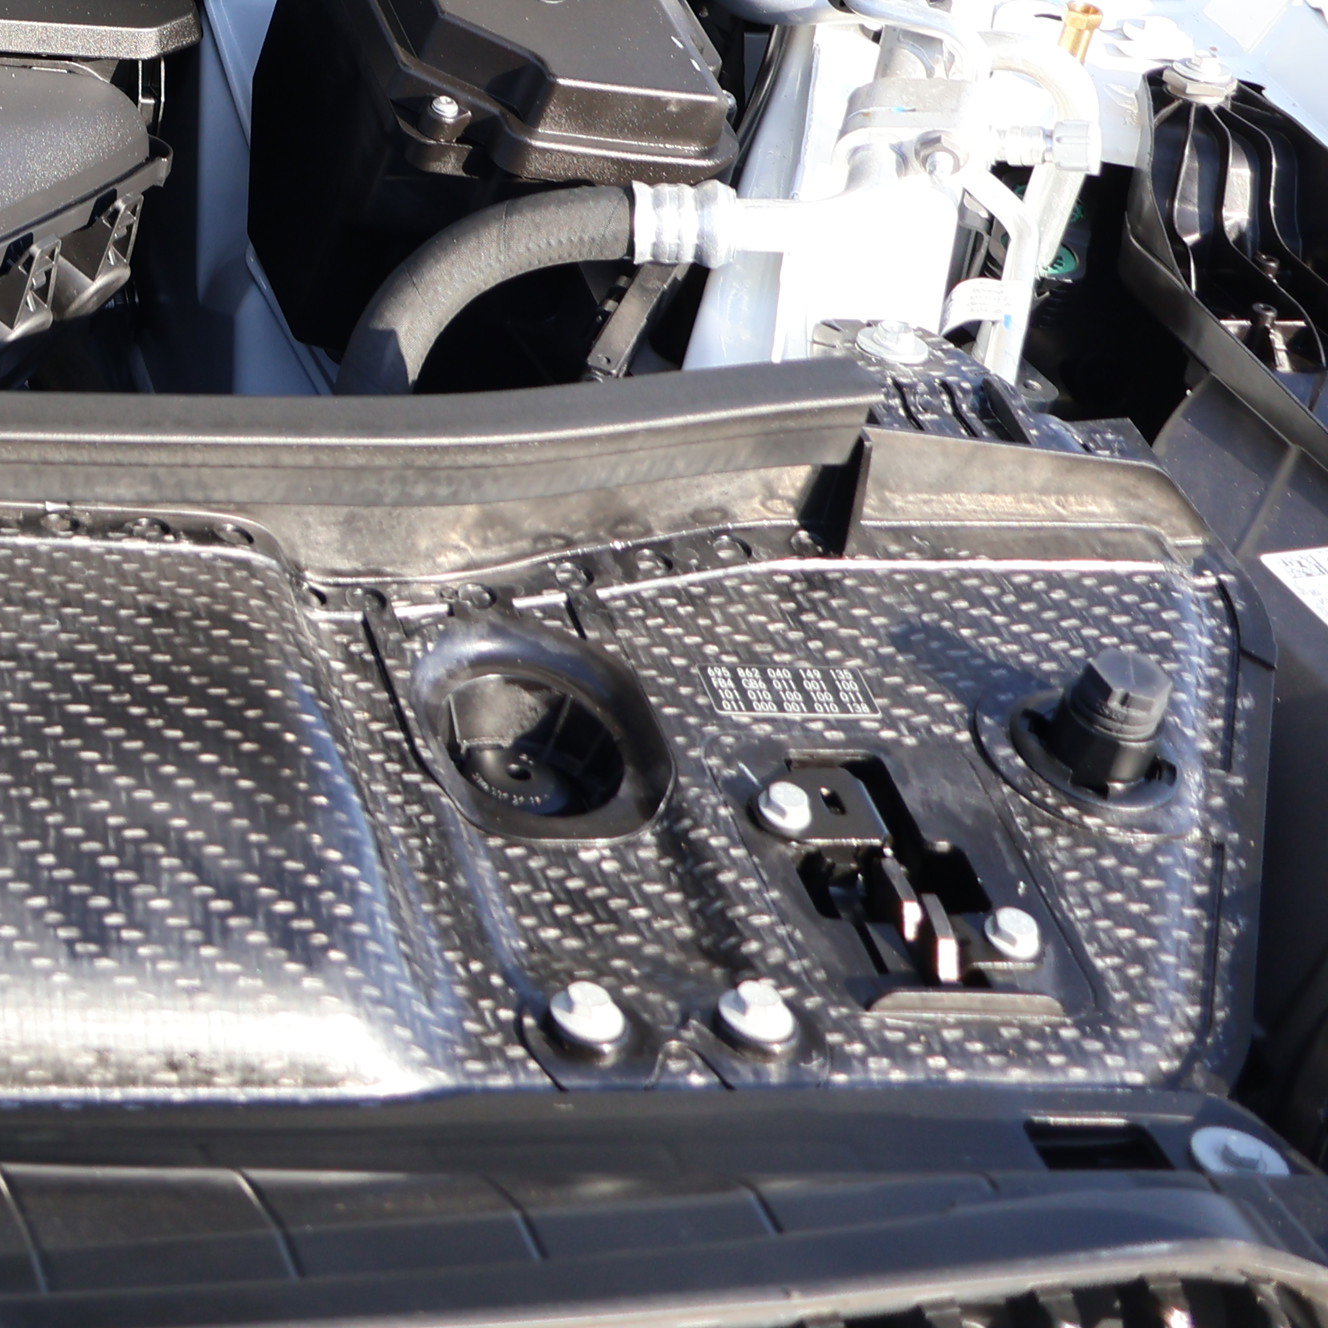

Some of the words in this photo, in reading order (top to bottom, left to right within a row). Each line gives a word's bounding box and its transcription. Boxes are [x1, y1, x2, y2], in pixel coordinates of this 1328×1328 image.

[707, 666, 731, 678] 695
[737, 667, 762, 678] 862
[767, 668, 792, 679] 040
[799, 668, 821, 680] 149
[830, 669, 853, 680] 135
[773, 679, 796, 690] 011
[803, 680, 826, 691] 001
[835, 680, 859, 691] 100
[718, 689, 741, 701] 101
[747, 690, 772, 701] 010
[779, 690, 803, 702] 100
[810, 691, 834, 703] 100
[840, 691, 863, 703] 011
[722, 700, 746, 711] 011
[752, 701, 778, 712] 000
[784, 701, 807, 712] 001
[814, 701, 839, 713] 010
